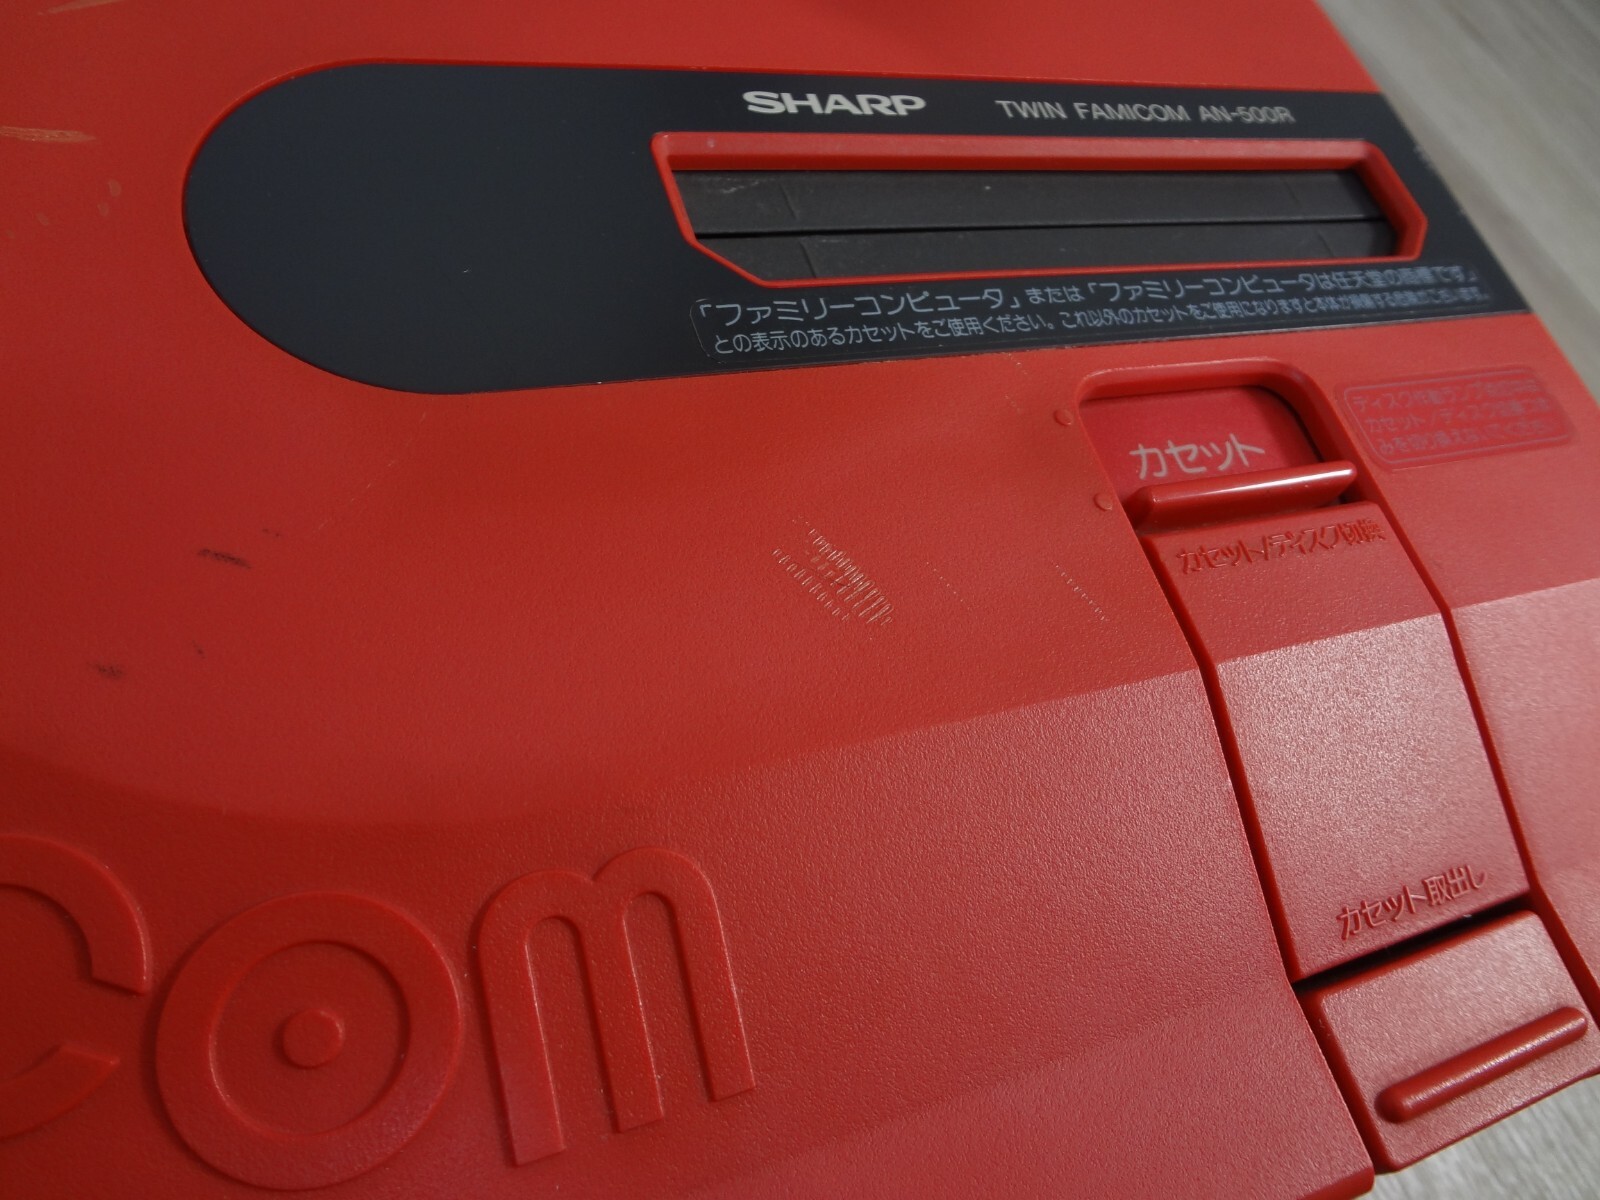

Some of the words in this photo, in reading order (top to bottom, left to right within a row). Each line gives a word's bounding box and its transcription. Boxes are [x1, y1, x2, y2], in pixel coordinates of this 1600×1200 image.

[742, 90, 927, 118] SHARP
[994, 100, 1069, 120] TWIN
[1073, 102, 1192, 123] FAMICOM
[1198, 105, 1297, 125] AN-500R
[1129, 432, 1265, 481] カセット
[1336, 864, 1488, 941] カセット取出し
